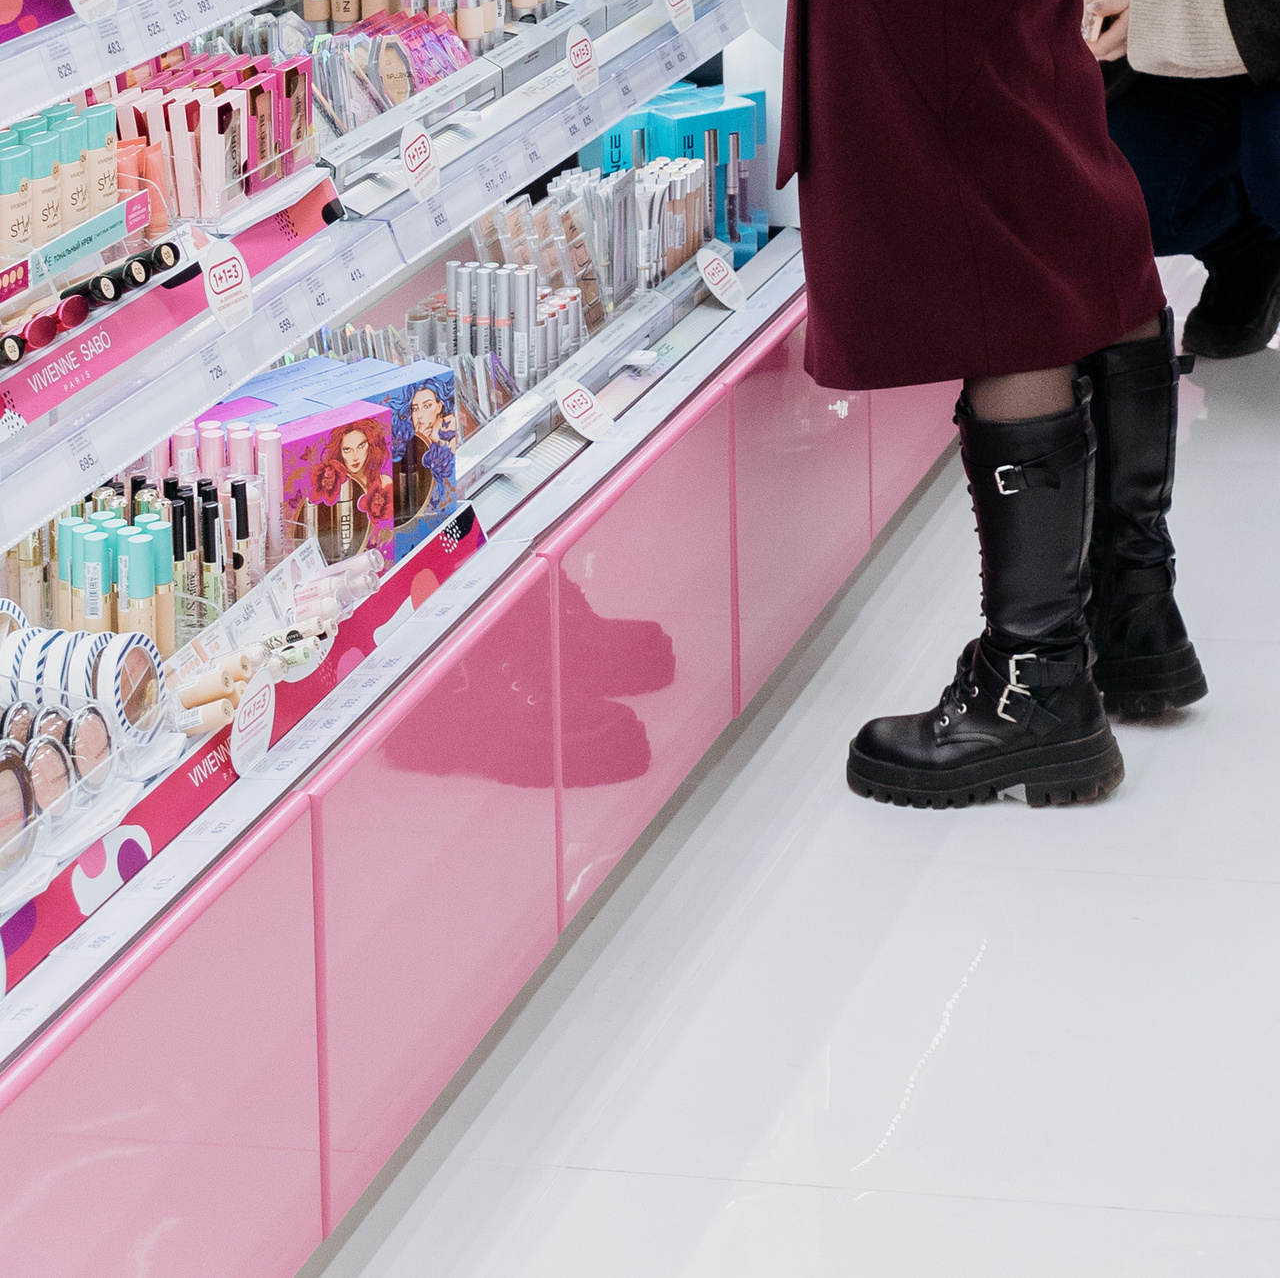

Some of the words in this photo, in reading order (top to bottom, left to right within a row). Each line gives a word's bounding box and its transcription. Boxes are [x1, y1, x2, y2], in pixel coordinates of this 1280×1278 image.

[571, 42, 591, 65] 1+1=3
[407, 138, 428, 164] 1+1=3
[213, 263, 240, 287] 1+1=3
[27, 349, 80, 393] VIVIENNE
[81, 326, 111, 361] SABÓ
[64, 370, 91, 392] PARIS
[241, 694, 266, 723] 1+1=3
